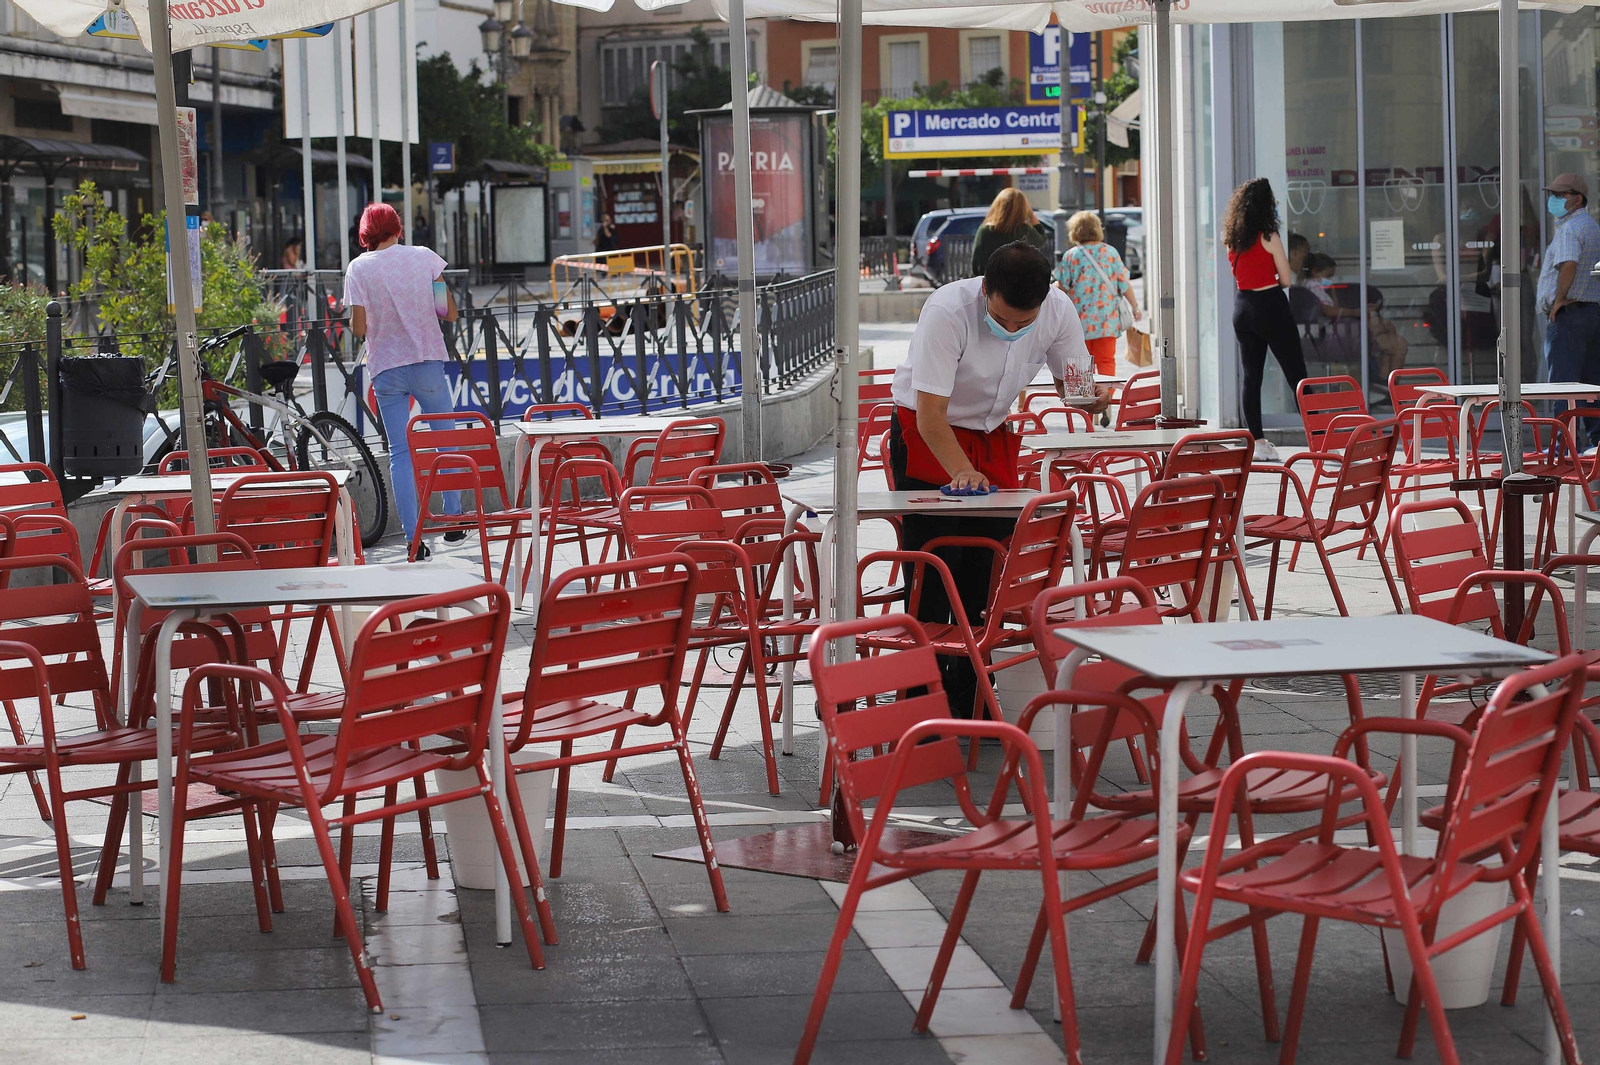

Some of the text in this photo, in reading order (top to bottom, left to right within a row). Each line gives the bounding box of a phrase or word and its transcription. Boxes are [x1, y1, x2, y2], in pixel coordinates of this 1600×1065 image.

[1043, 27, 1074, 65] P
[894, 113, 911, 136] P
[925, 113, 1000, 130] Mercado
[1331, 166, 1500, 187] DENTIX
